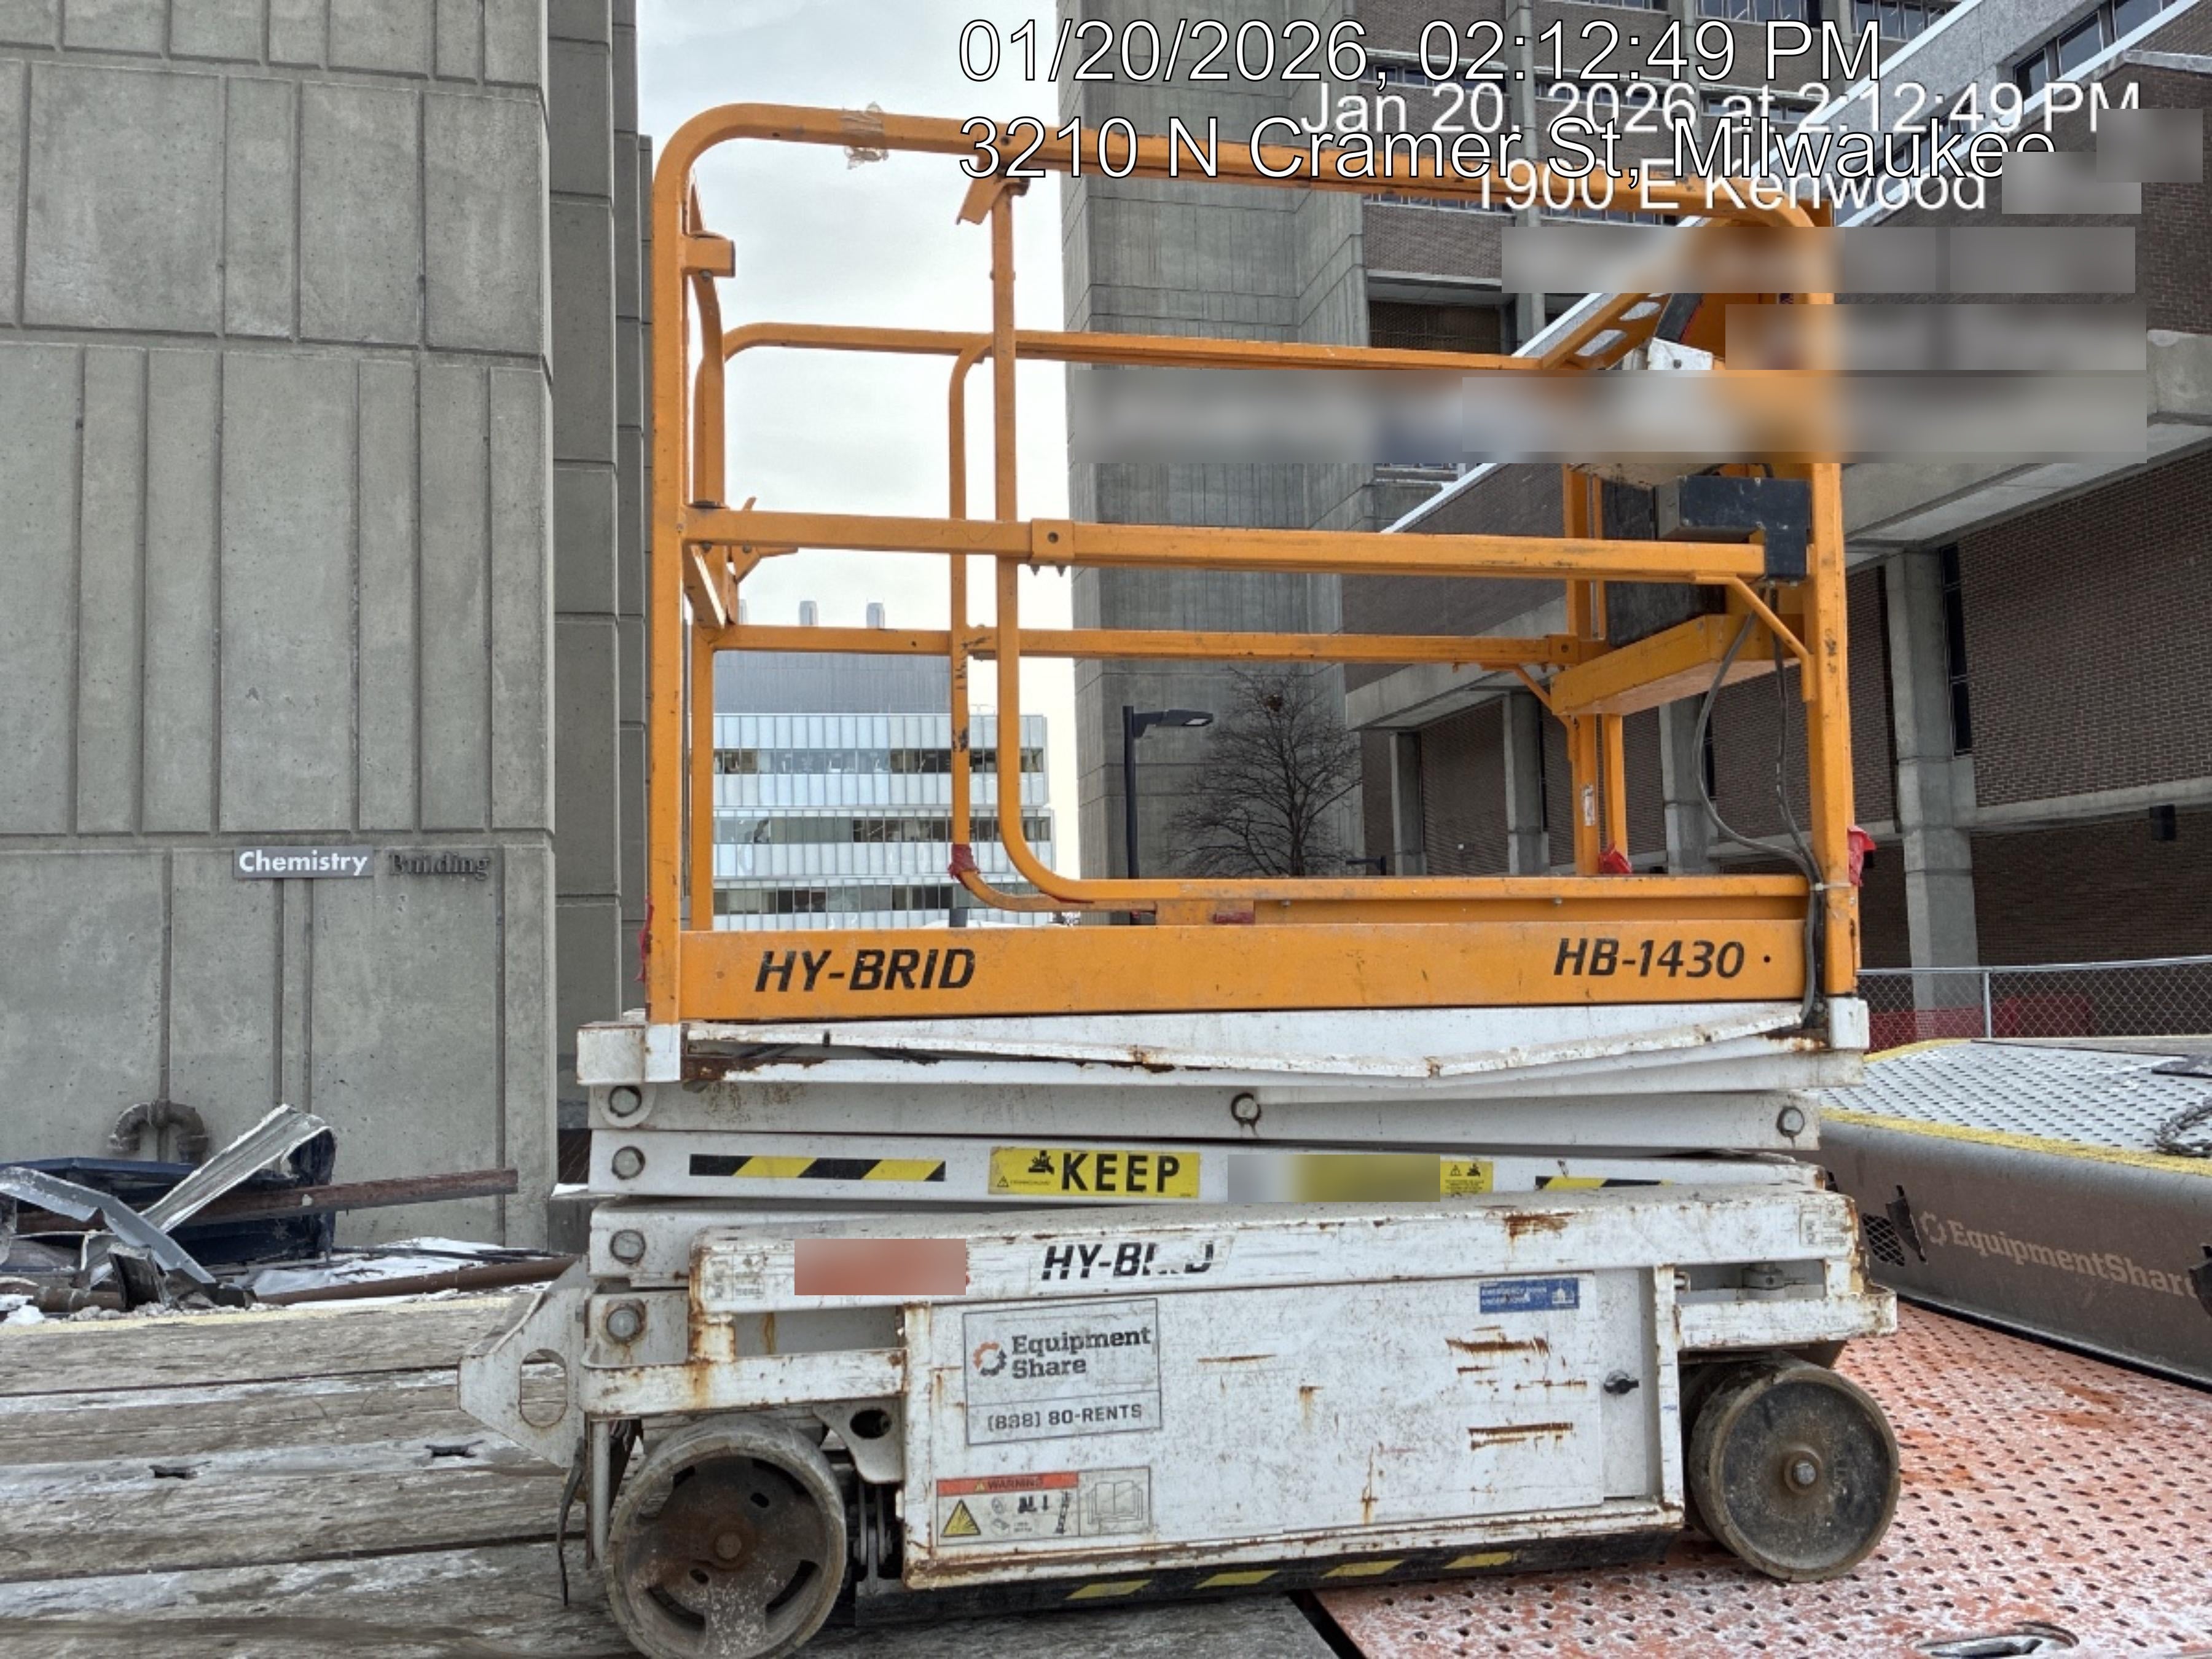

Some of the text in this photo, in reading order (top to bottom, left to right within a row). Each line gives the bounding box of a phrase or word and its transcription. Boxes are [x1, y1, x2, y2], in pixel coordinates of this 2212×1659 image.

[239, 849, 367, 876] Chemistry
[755, 948, 976, 992] HY-BRID
[1553, 938, 1745, 979] HB-1430
[1062, 1153, 1180, 1193] KEEP
[1011, 1327, 1151, 1357] Equipment
[1013, 1357, 1087, 1379] Share
[1048, 1404, 1142, 1426] 80-RENTS
